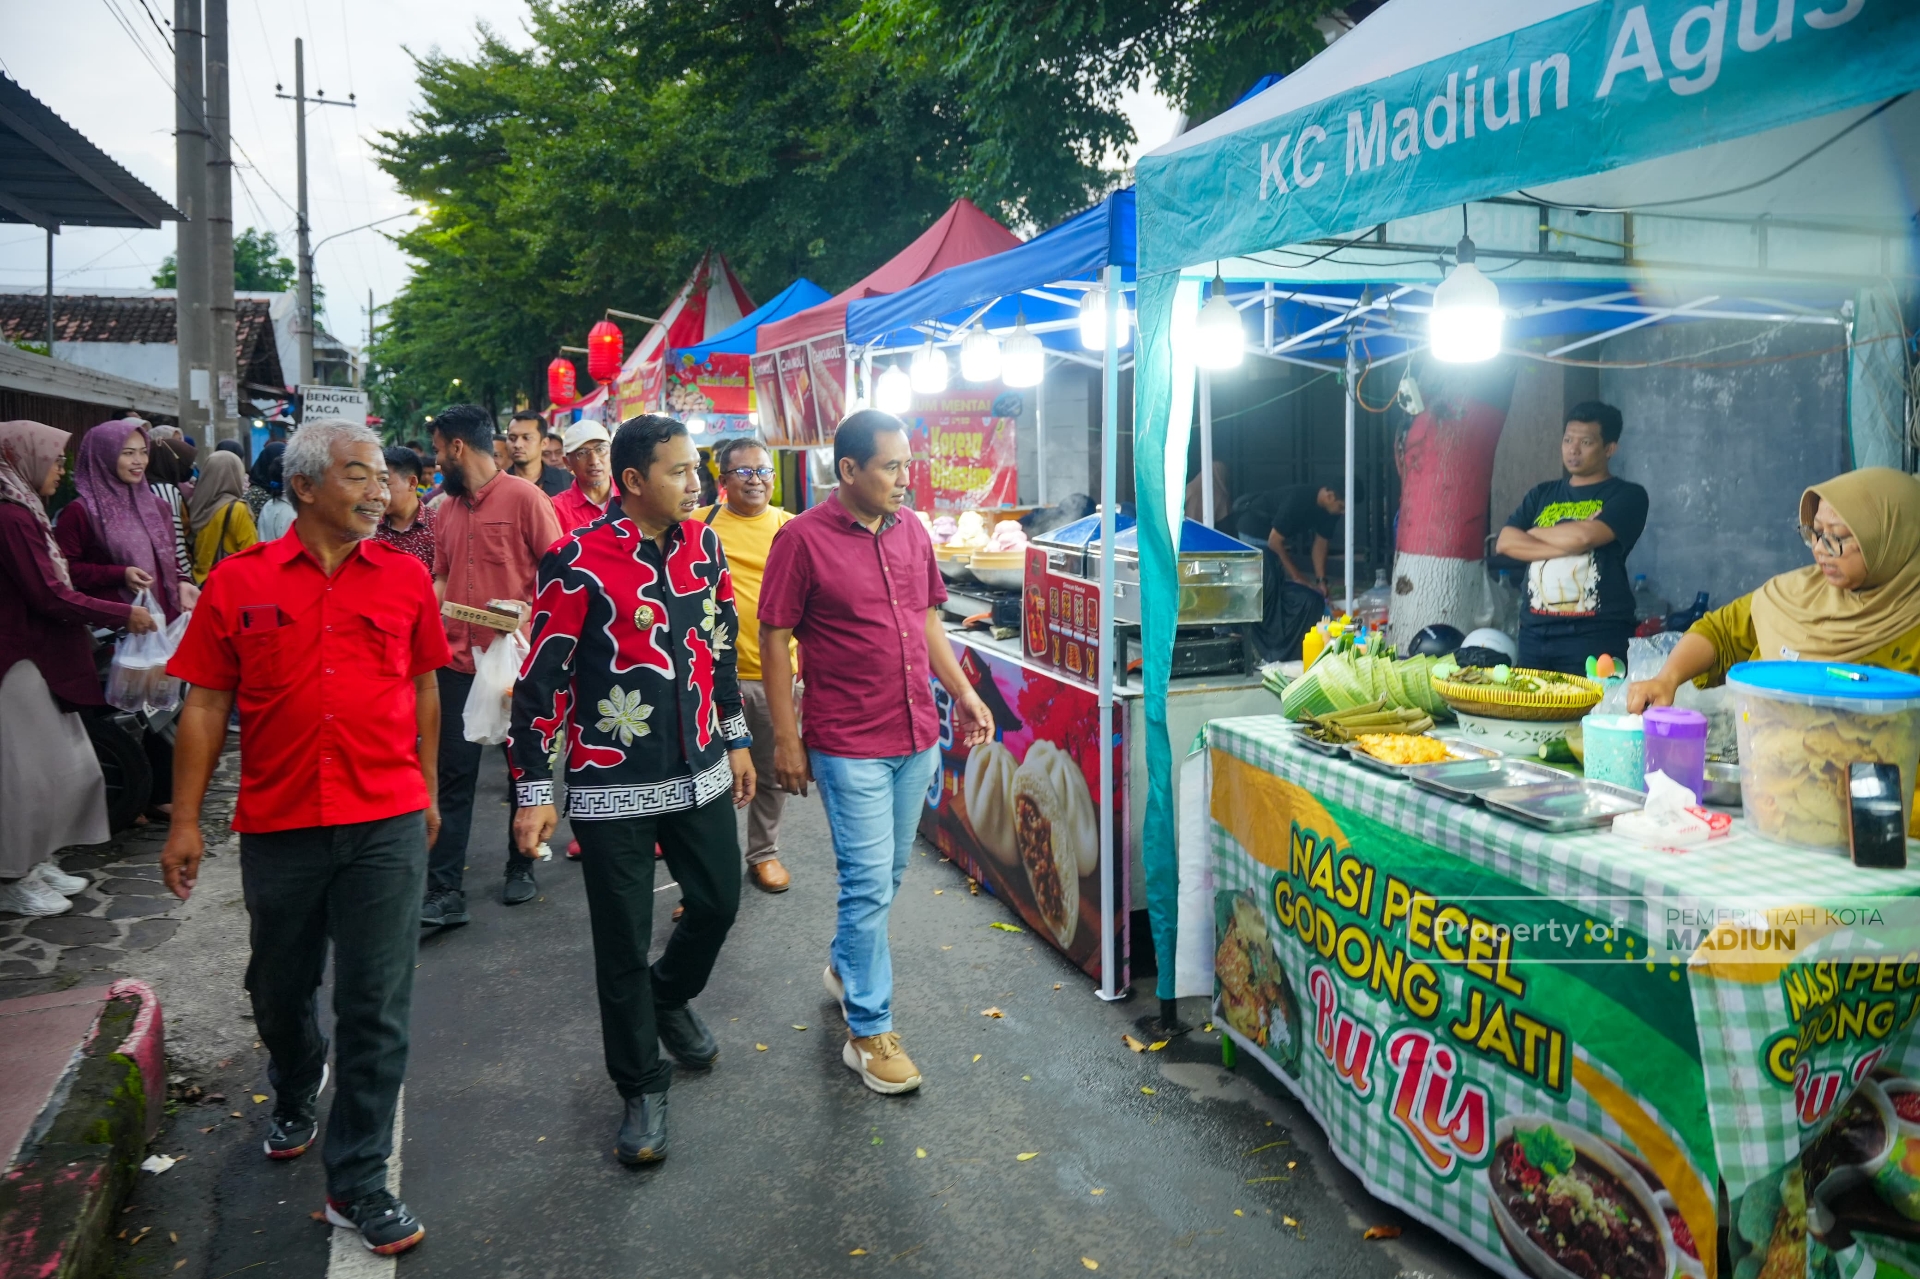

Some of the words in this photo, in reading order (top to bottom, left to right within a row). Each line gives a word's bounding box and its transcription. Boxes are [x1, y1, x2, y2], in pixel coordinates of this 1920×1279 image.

[1259, 125, 1326, 200] KC
[1345, 52, 1569, 176] Madiun
[305, 404, 341, 414] KACA
[306, 393, 363, 404] BENGKEL
[941, 399, 991, 412] MENTAI
[930, 426, 983, 459] Korean
[1291, 830, 1375, 916] NASI
[1383, 877, 1525, 996] PECEL
[1274, 879, 1440, 1018] GODONG
[1451, 989, 1563, 1089] JATI
[1785, 956, 1839, 1021] NASI
[1845, 951, 1920, 993] PEC
[1309, 967, 1376, 1094] Bu
[1389, 1031, 1486, 1172] Lis
